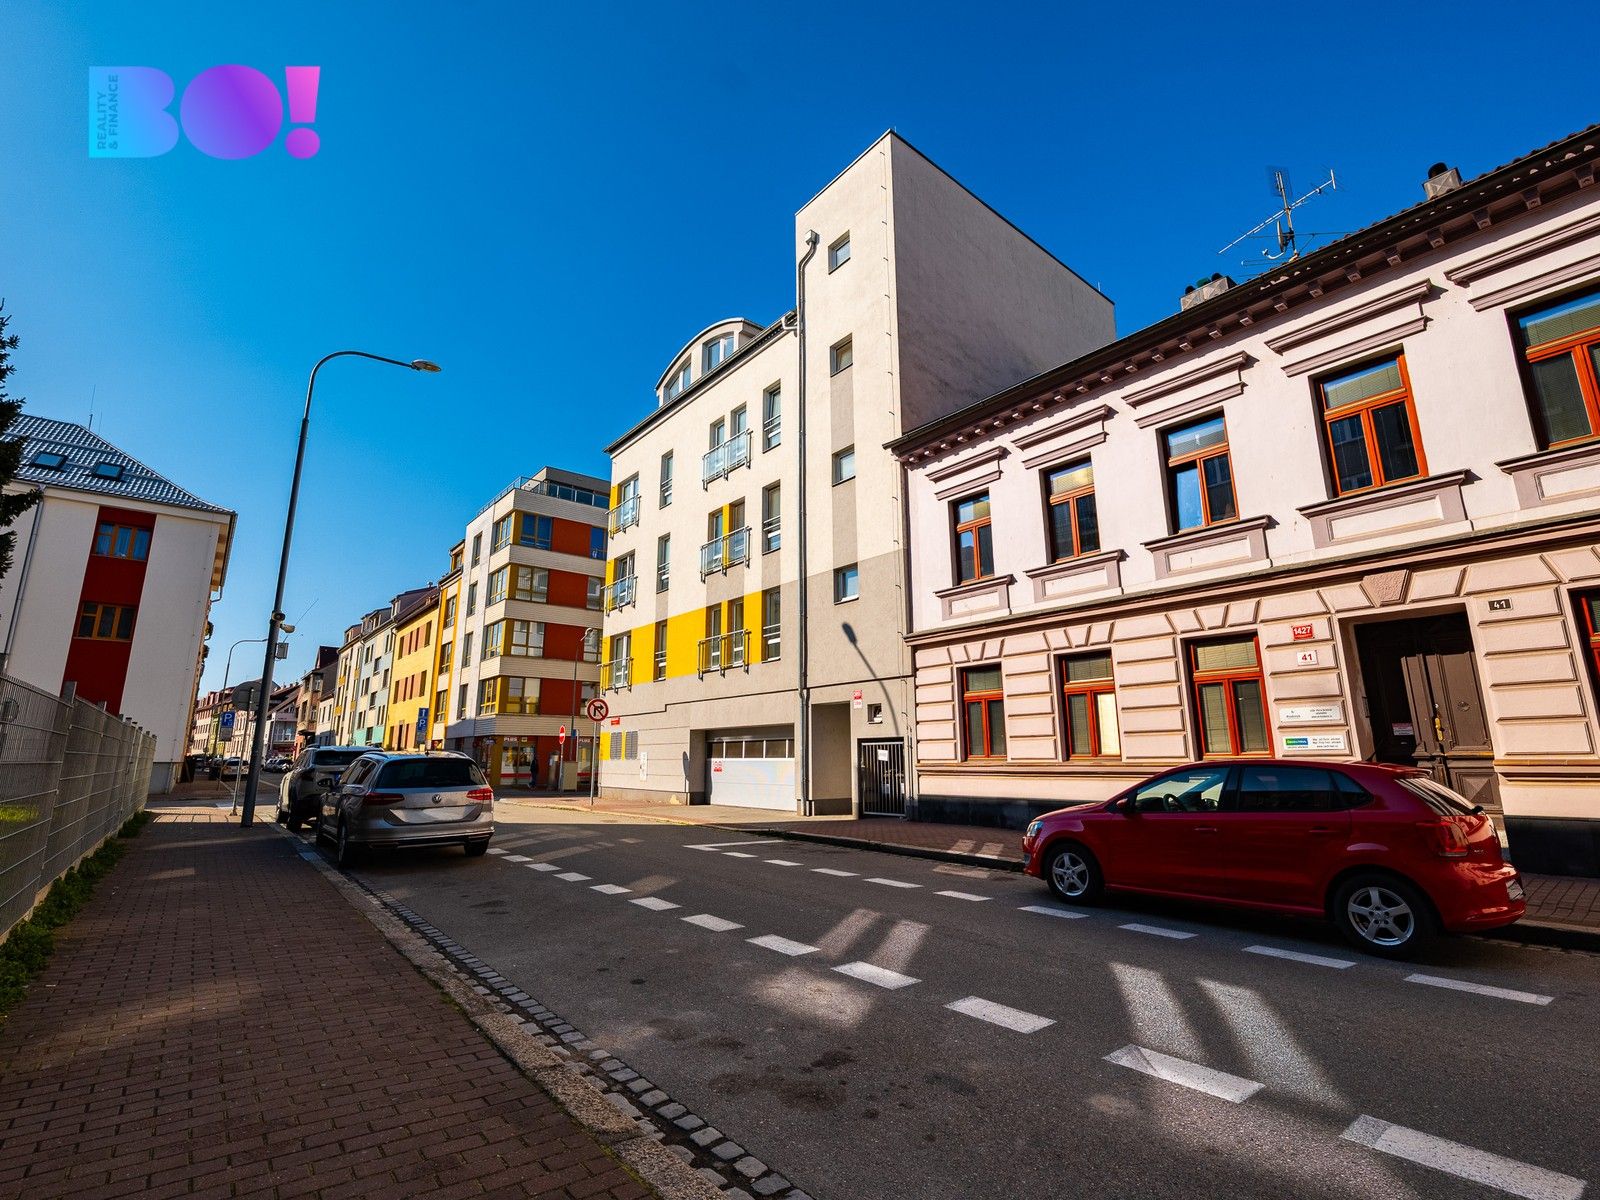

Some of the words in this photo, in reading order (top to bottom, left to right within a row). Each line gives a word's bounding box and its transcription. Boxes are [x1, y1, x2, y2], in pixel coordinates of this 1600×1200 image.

[1493, 600, 1506, 609] 41
[1293, 626, 1311, 635] 1427
[1301, 653, 1313, 661] 41
